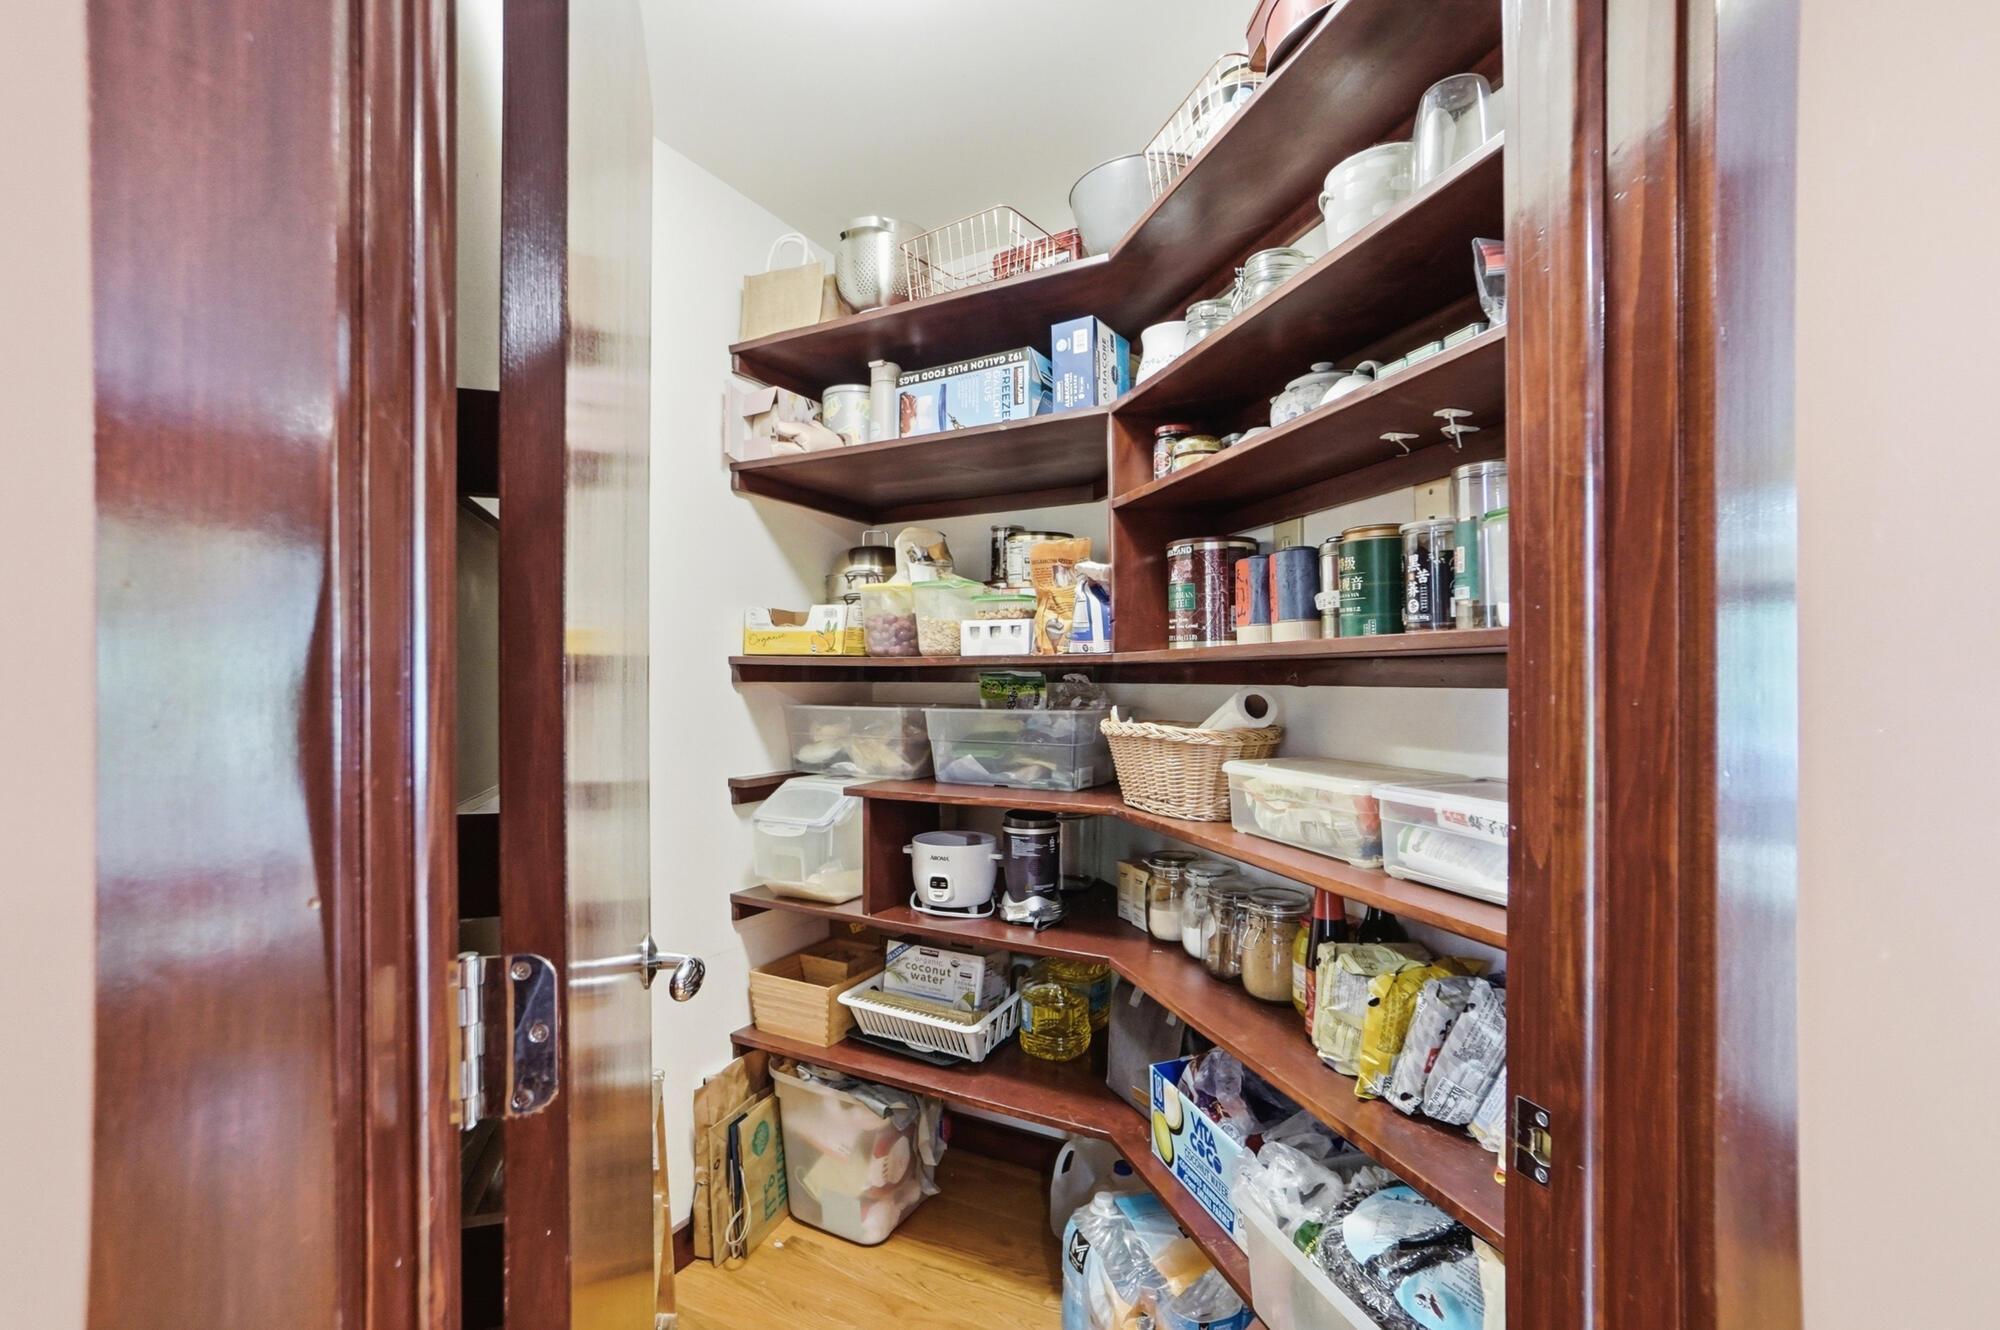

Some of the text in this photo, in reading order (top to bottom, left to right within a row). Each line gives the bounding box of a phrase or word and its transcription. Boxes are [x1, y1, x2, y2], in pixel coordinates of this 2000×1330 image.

[899, 351, 1023, 386] 192 GALLON PLUS FOOD BAGS
[905, 961, 951, 978] coconut
[910, 972, 945, 985] water
[1154, 1073, 1163, 1103] 18
[1190, 1110, 1217, 1154] VITA
[1190, 1131, 1222, 1175] COCO
[1184, 1147, 1229, 1200] COCONUT WATER
